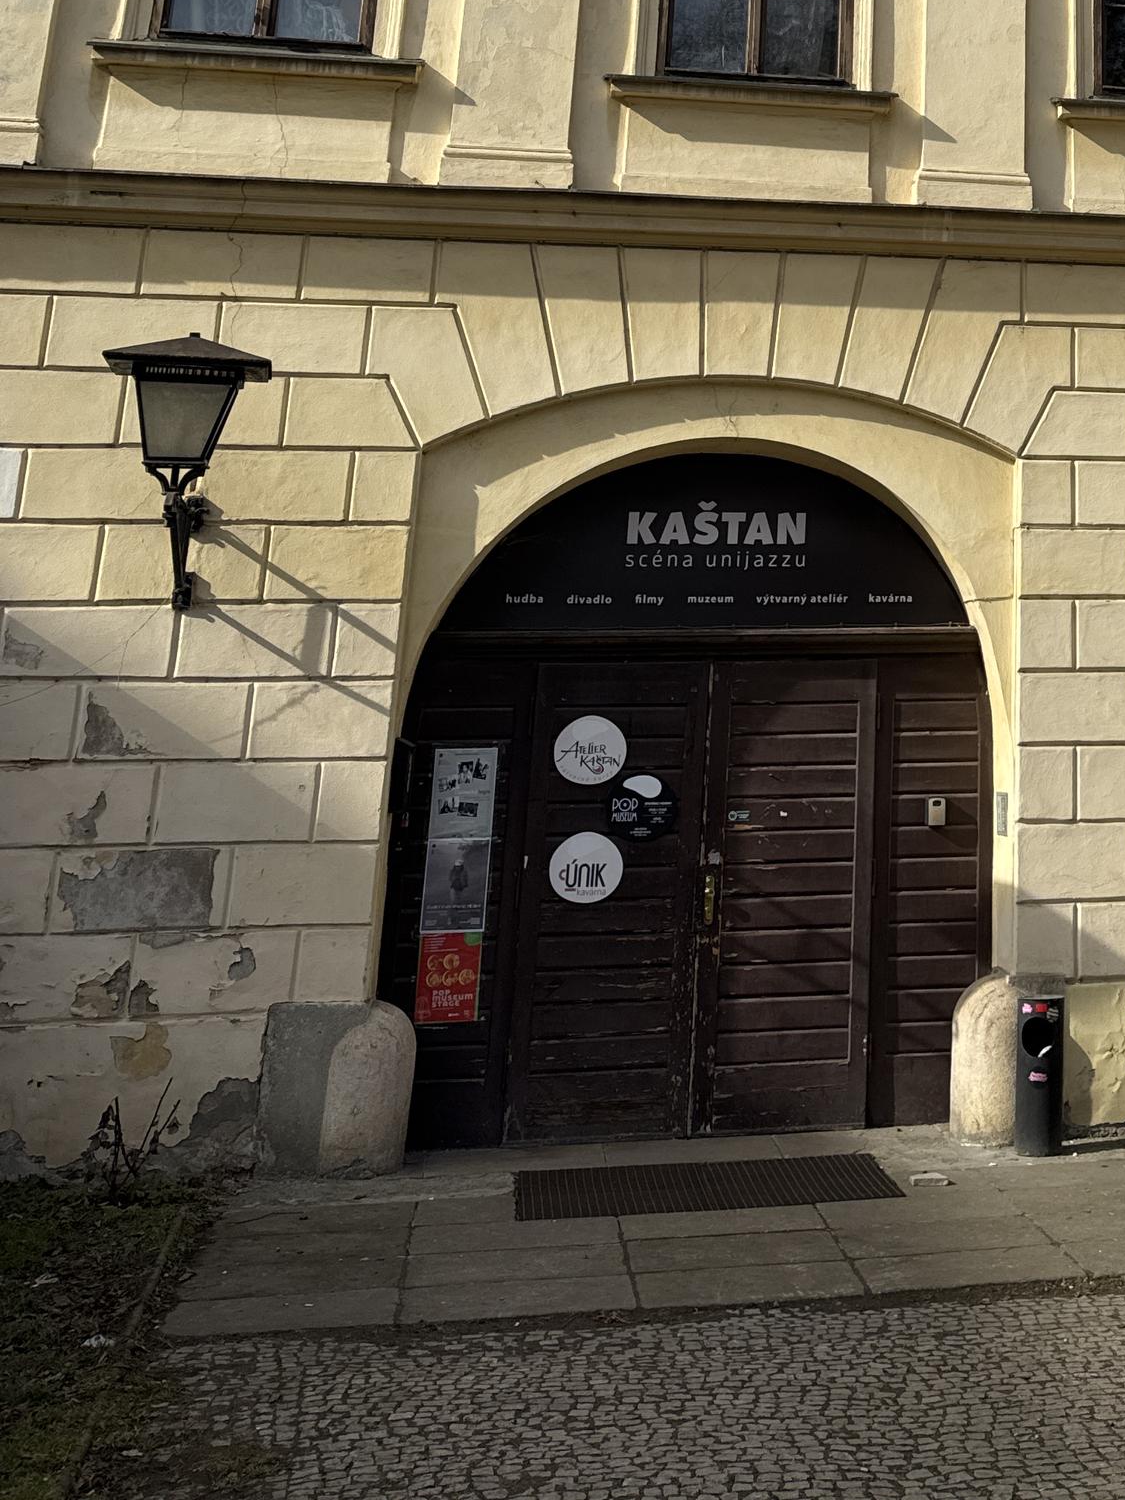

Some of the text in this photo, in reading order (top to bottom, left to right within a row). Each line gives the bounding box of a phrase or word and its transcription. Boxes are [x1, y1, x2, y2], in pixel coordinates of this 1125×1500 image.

[626, 500, 807, 545] KAŠTAN
[625, 549, 806, 571] scéna unijazzu
[505, 593, 913, 606] hudba divadlo filmy muzeum výtvarný ateliér kavárna
[612, 798, 639, 812] POP
[611, 811, 638, 822] MUSEUM
[565, 858, 607, 888] ÚNIK
